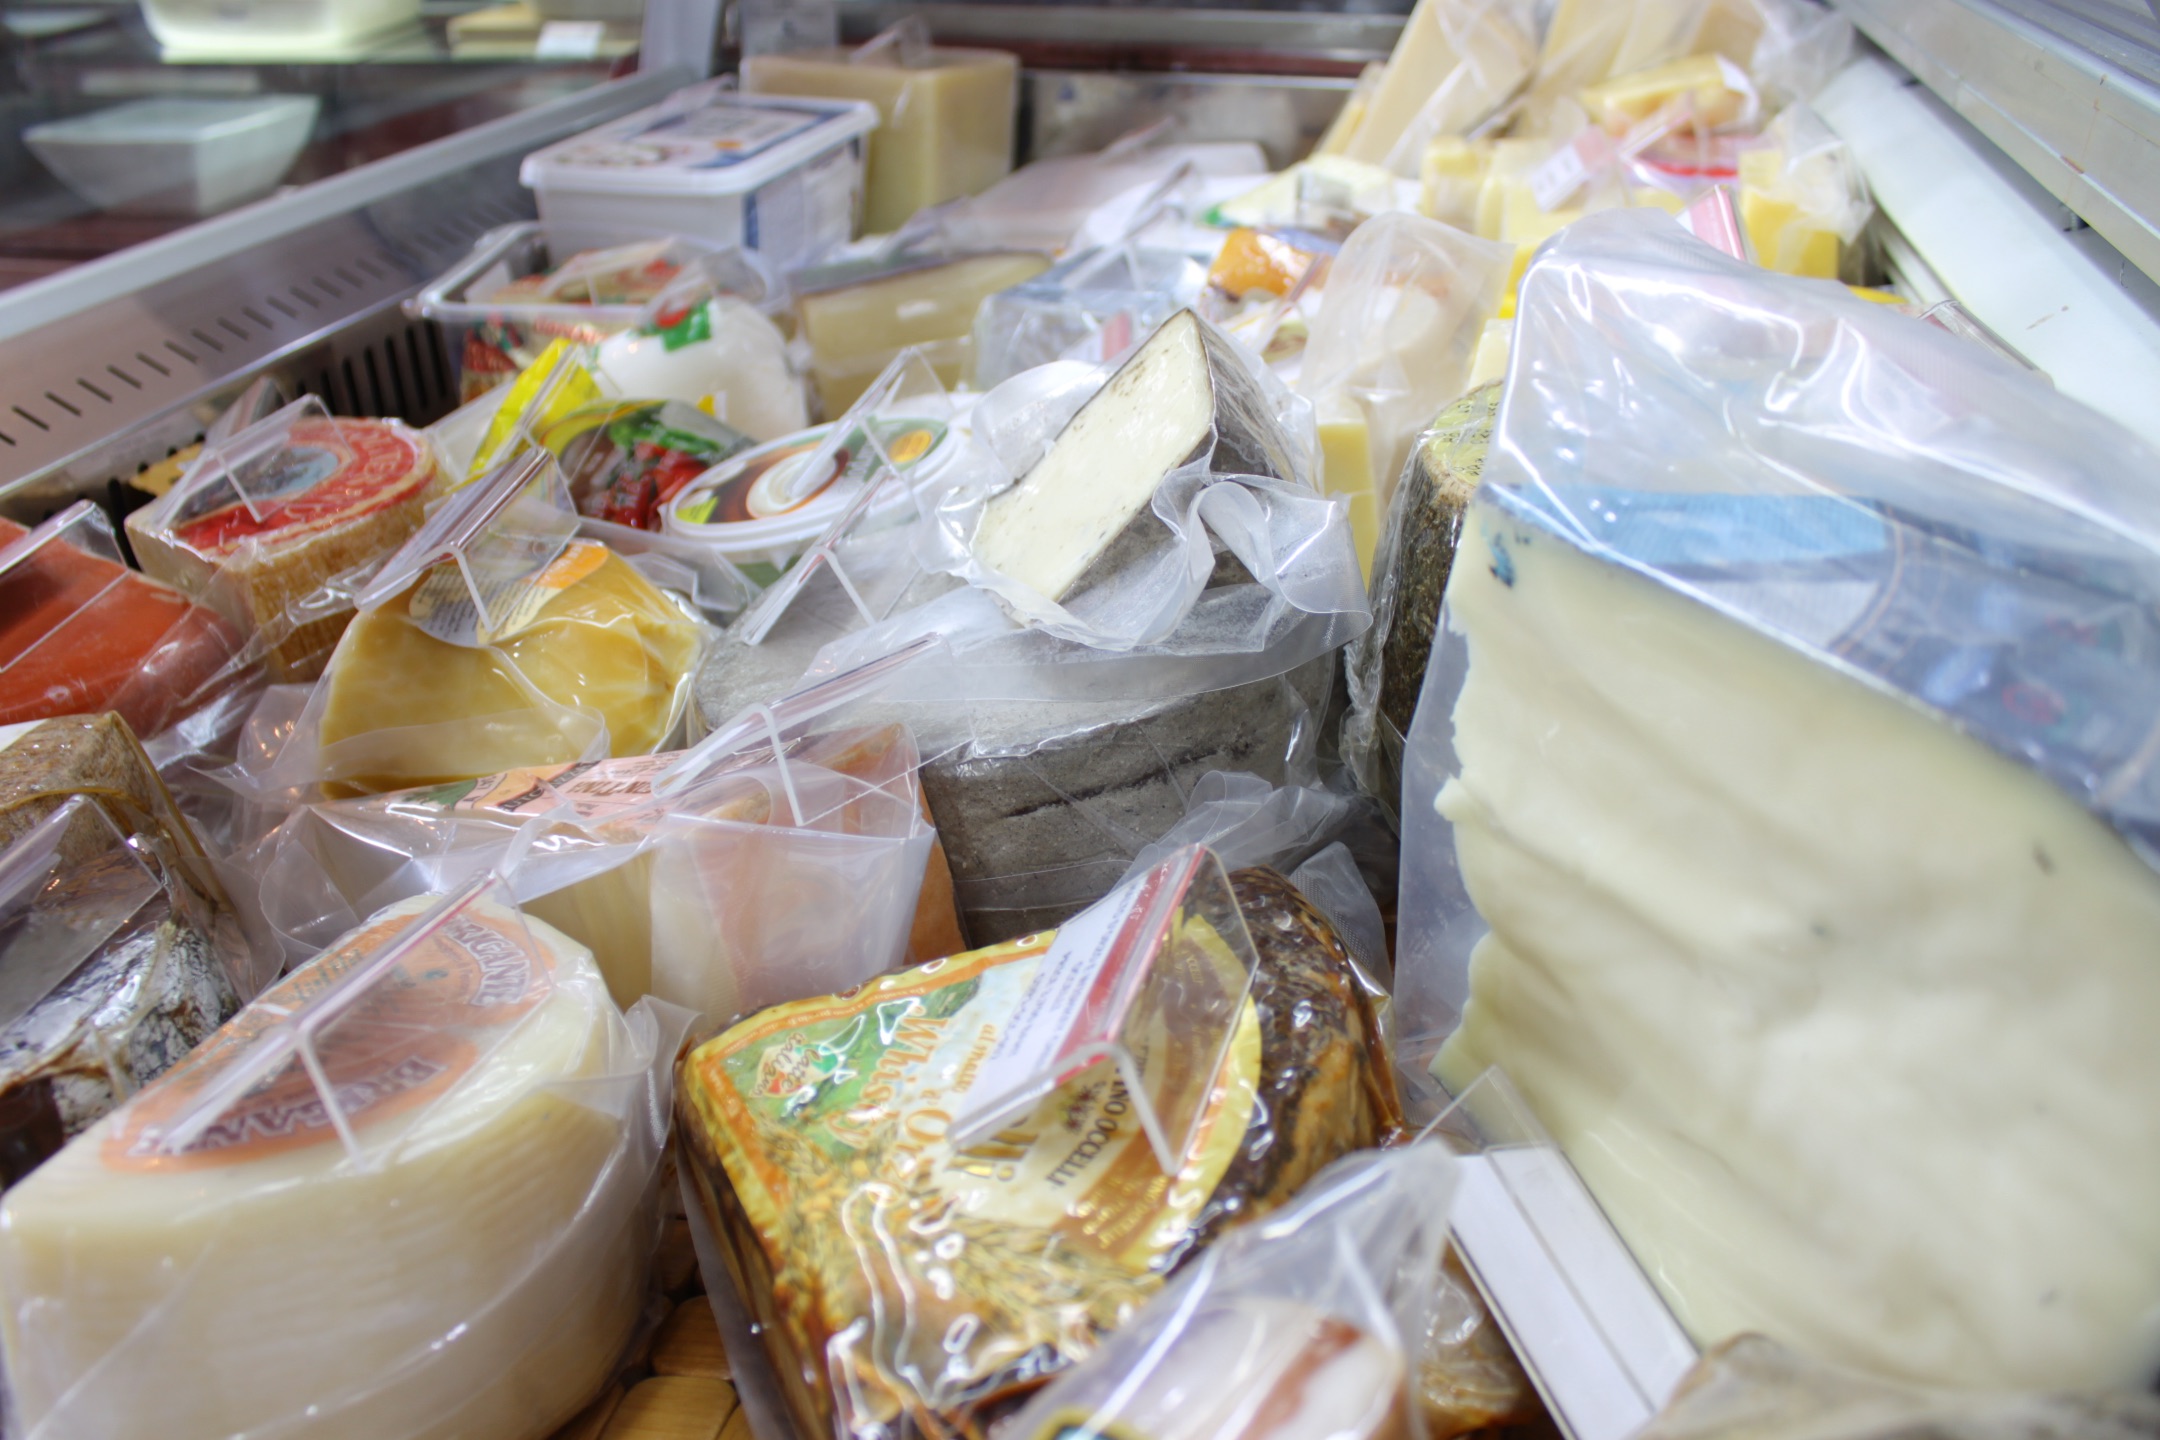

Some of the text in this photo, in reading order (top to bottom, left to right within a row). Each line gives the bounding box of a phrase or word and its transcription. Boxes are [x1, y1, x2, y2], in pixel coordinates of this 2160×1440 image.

[440, 915, 532, 1007] RIGANTE
[780, 1047, 819, 1092] latte
[1045, 1117, 1117, 1188] OCCELLI
